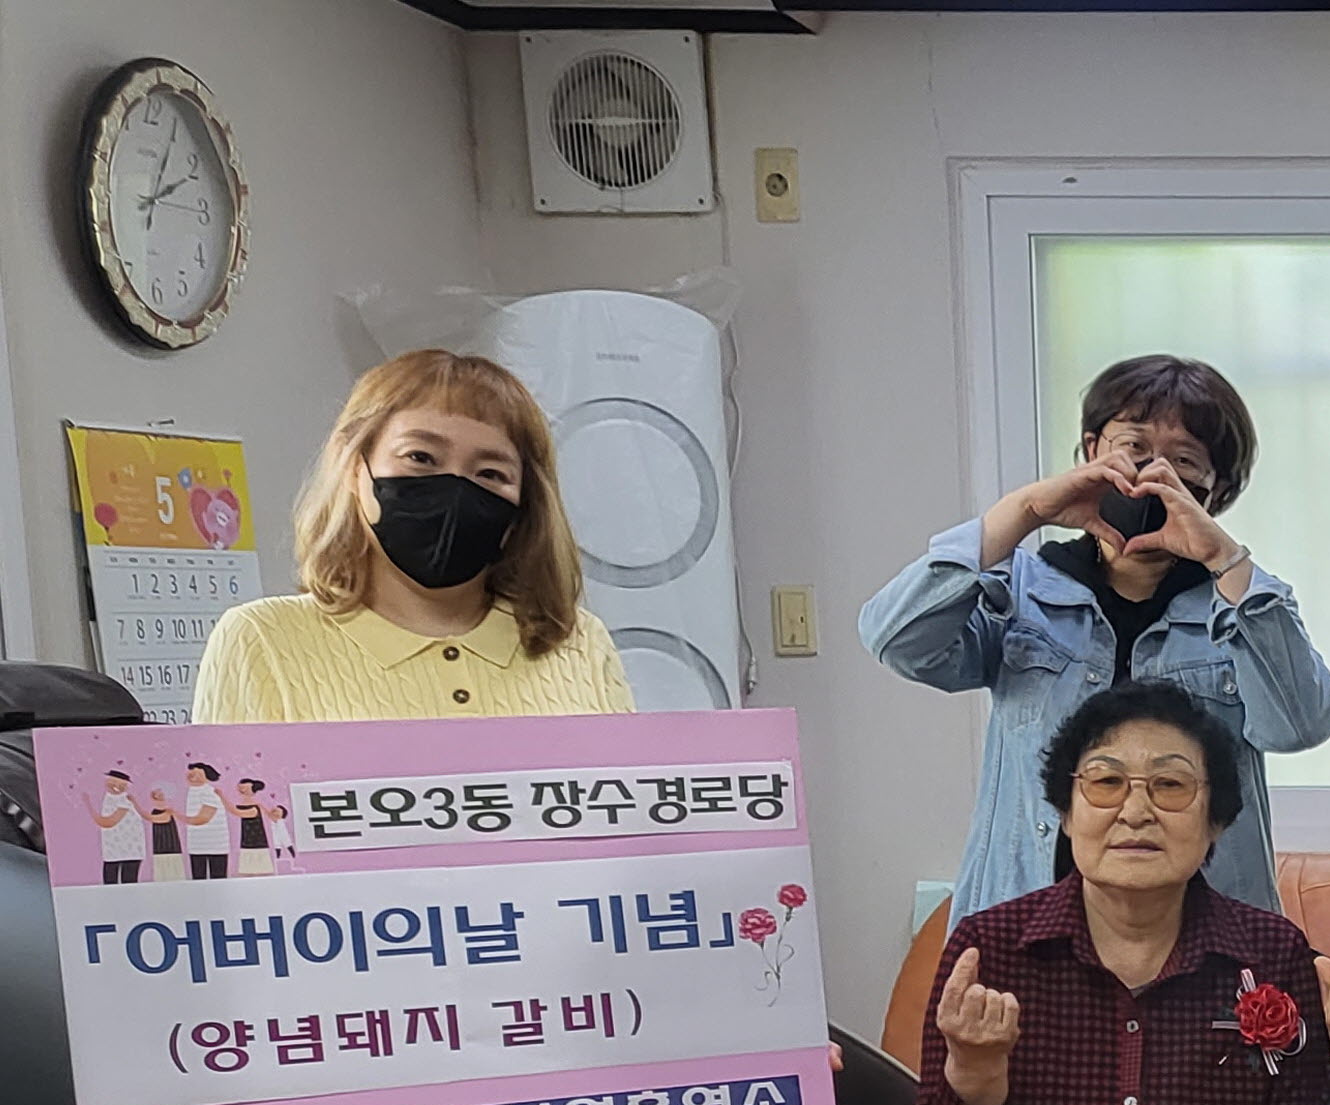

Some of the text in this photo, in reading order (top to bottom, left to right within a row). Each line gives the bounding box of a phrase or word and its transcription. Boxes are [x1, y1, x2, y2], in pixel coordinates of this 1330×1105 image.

[143, 97, 162, 127] 12
[170, 117, 177, 142] 1
[187, 153, 198, 180] 2
[194, 240, 205, 270] 4
[151, 277, 163, 305] 6
[177, 269, 188, 298] 5
[155, 476, 175, 525] 5
[132, 574, 239, 595] 1 2 3 4 5 6
[117, 619, 125, 638] 7
[136, 619, 145, 639] 8
[155, 619, 164, 639] 9
[172, 619, 186, 639] 10
[191, 619, 204, 638] 11
[121, 665, 190, 686] 14 15 16 17
[308, 773, 789, 839] 본오3동 장수경로당
[85, 889, 735, 984] 「어버이의날 기념」
[167, 987, 644, 1075] (양념돼지 갈비)
